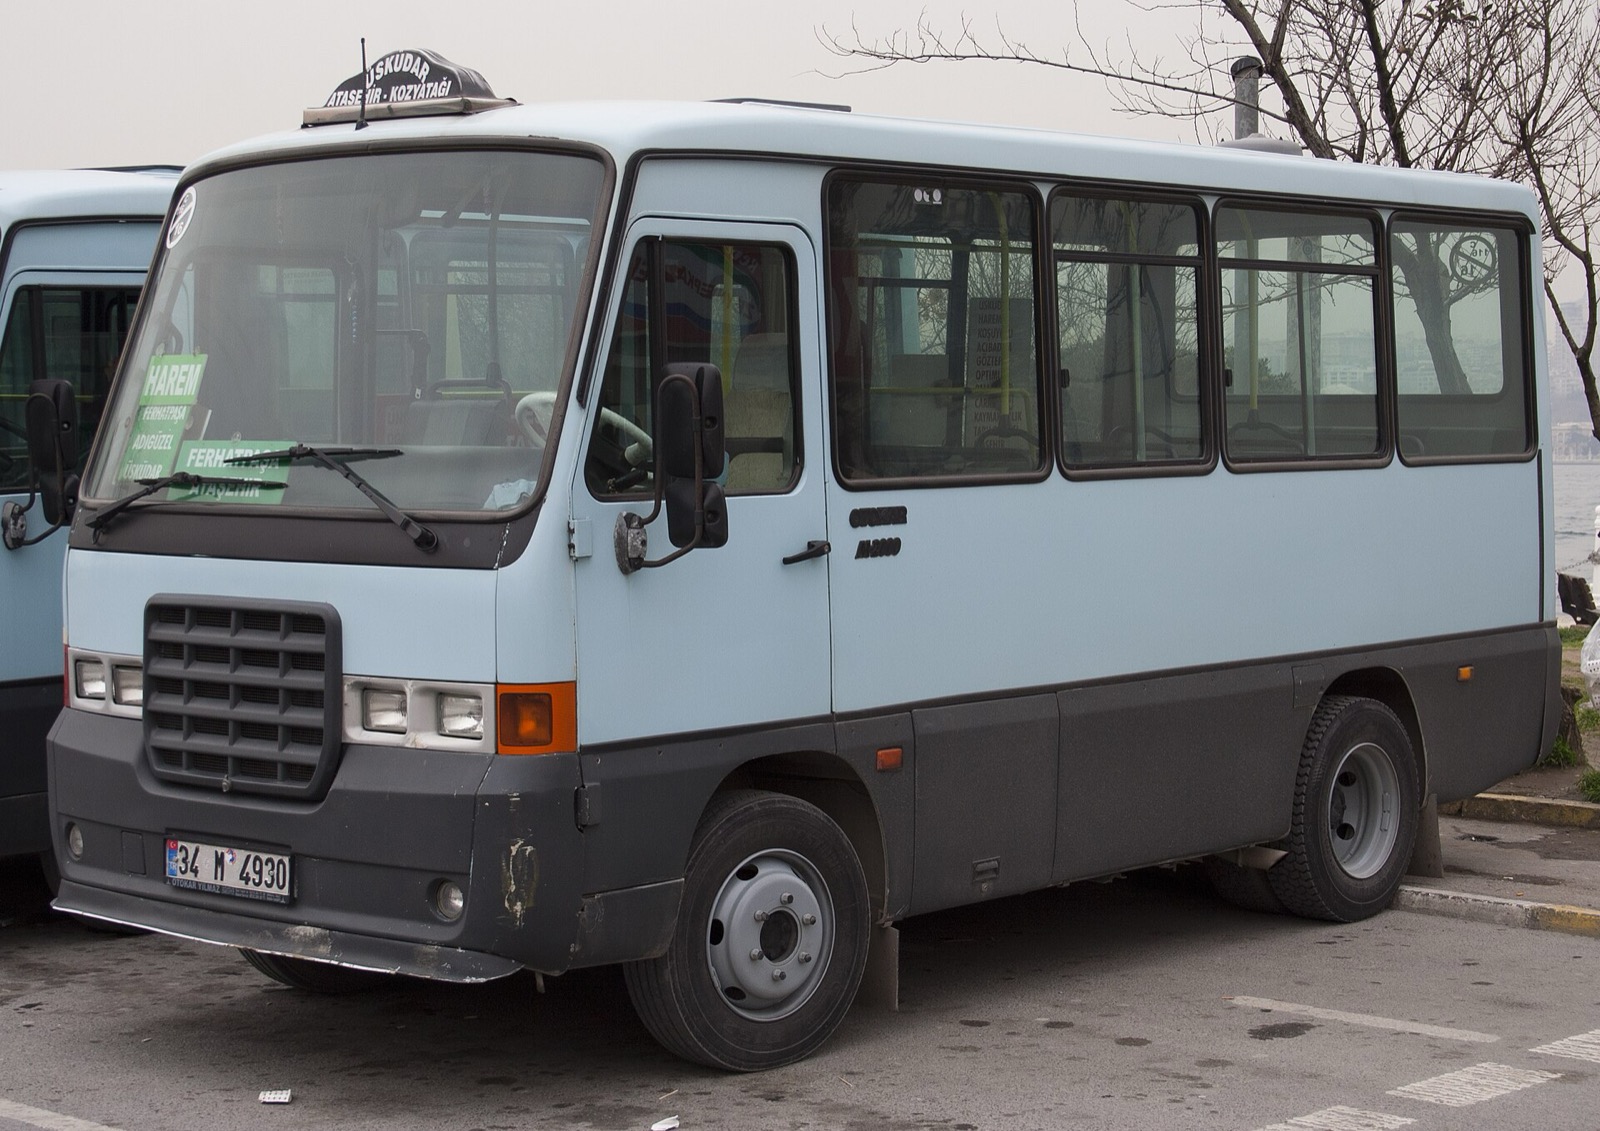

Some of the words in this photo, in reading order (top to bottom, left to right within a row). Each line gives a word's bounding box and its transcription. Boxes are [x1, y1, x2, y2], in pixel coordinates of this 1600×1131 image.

[366, 49, 430, 89] ÜSKÜDAR
[389, 77, 451, 101] KOZYATAĞI
[144, 364, 201, 396] HAREM
[143, 406, 186, 424] FERHATPAŞA
[132, 431, 173, 450] ADIGÜZEL
[123, 460, 162, 479] ÜSKÜDAR
[178, 845, 200, 878] 34
[214, 850, 225, 881] M
[240, 854, 287, 890] 4930
